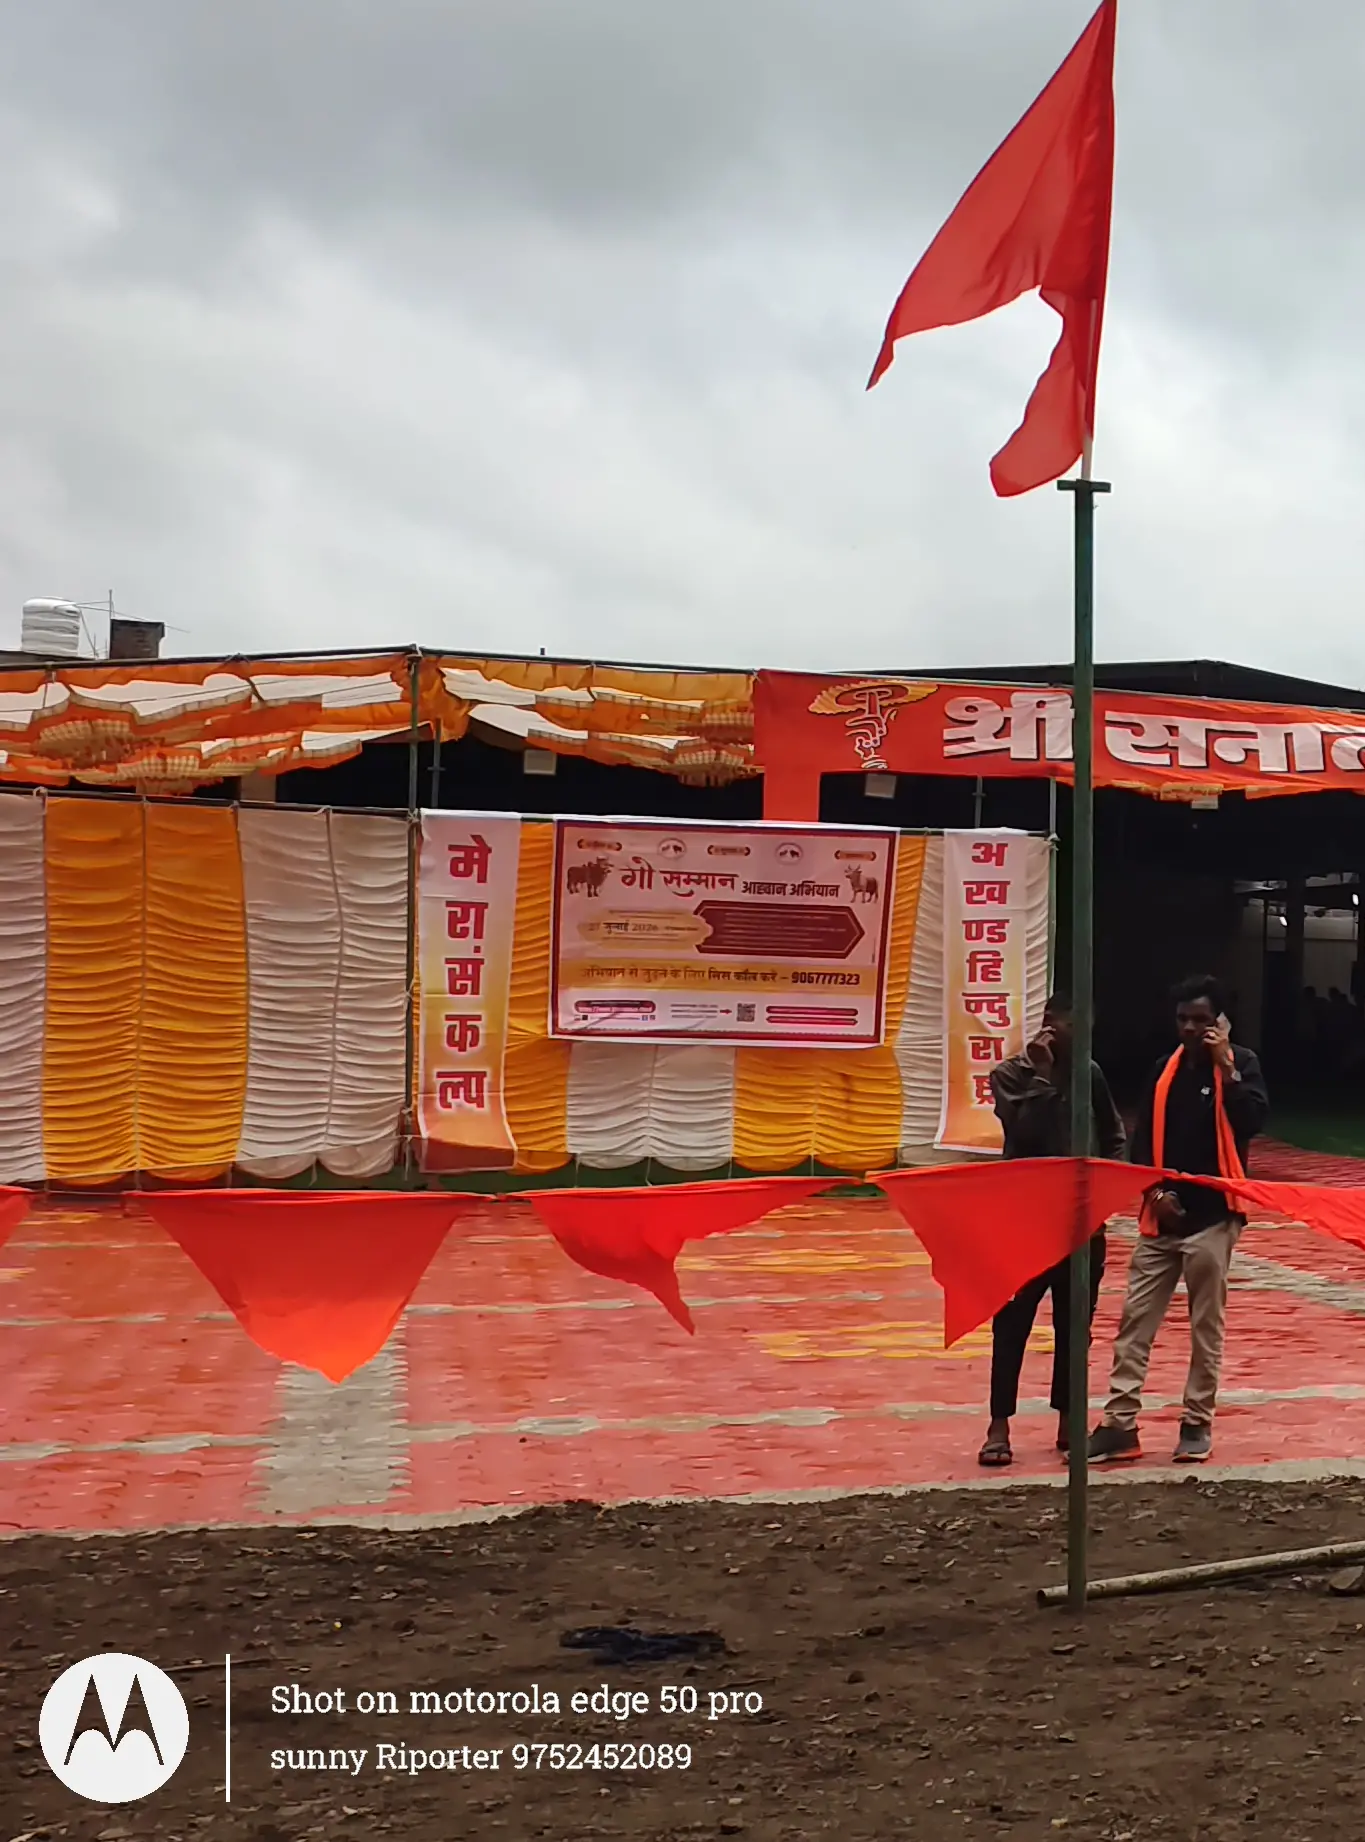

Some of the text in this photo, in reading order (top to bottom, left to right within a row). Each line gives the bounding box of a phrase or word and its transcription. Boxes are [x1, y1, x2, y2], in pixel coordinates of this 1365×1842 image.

[943, 691, 1076, 761] श्री
[659, 869, 740, 898] सम्मान
[789, 880, 841, 898] अभियान
